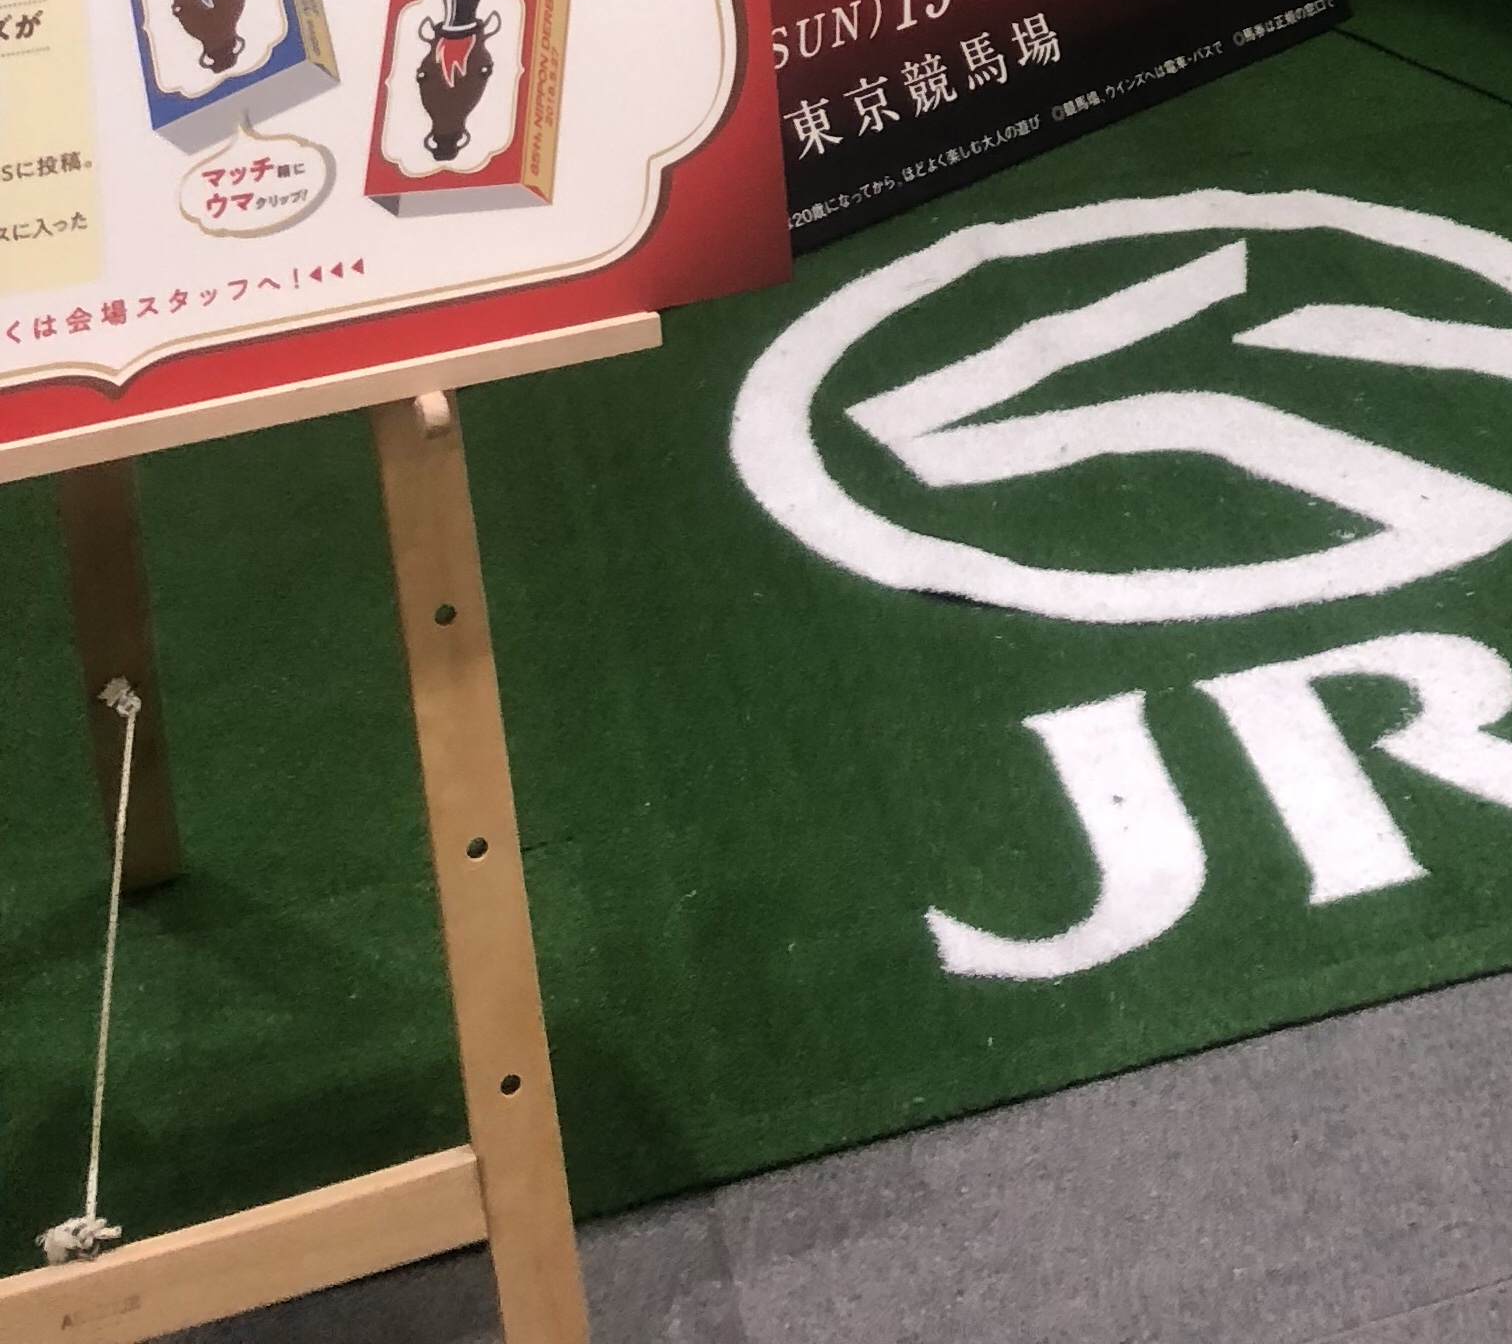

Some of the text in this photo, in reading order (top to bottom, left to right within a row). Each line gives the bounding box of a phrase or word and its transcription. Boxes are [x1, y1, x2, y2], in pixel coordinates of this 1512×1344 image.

[783, 12, 1062, 161] 東京競馬場
